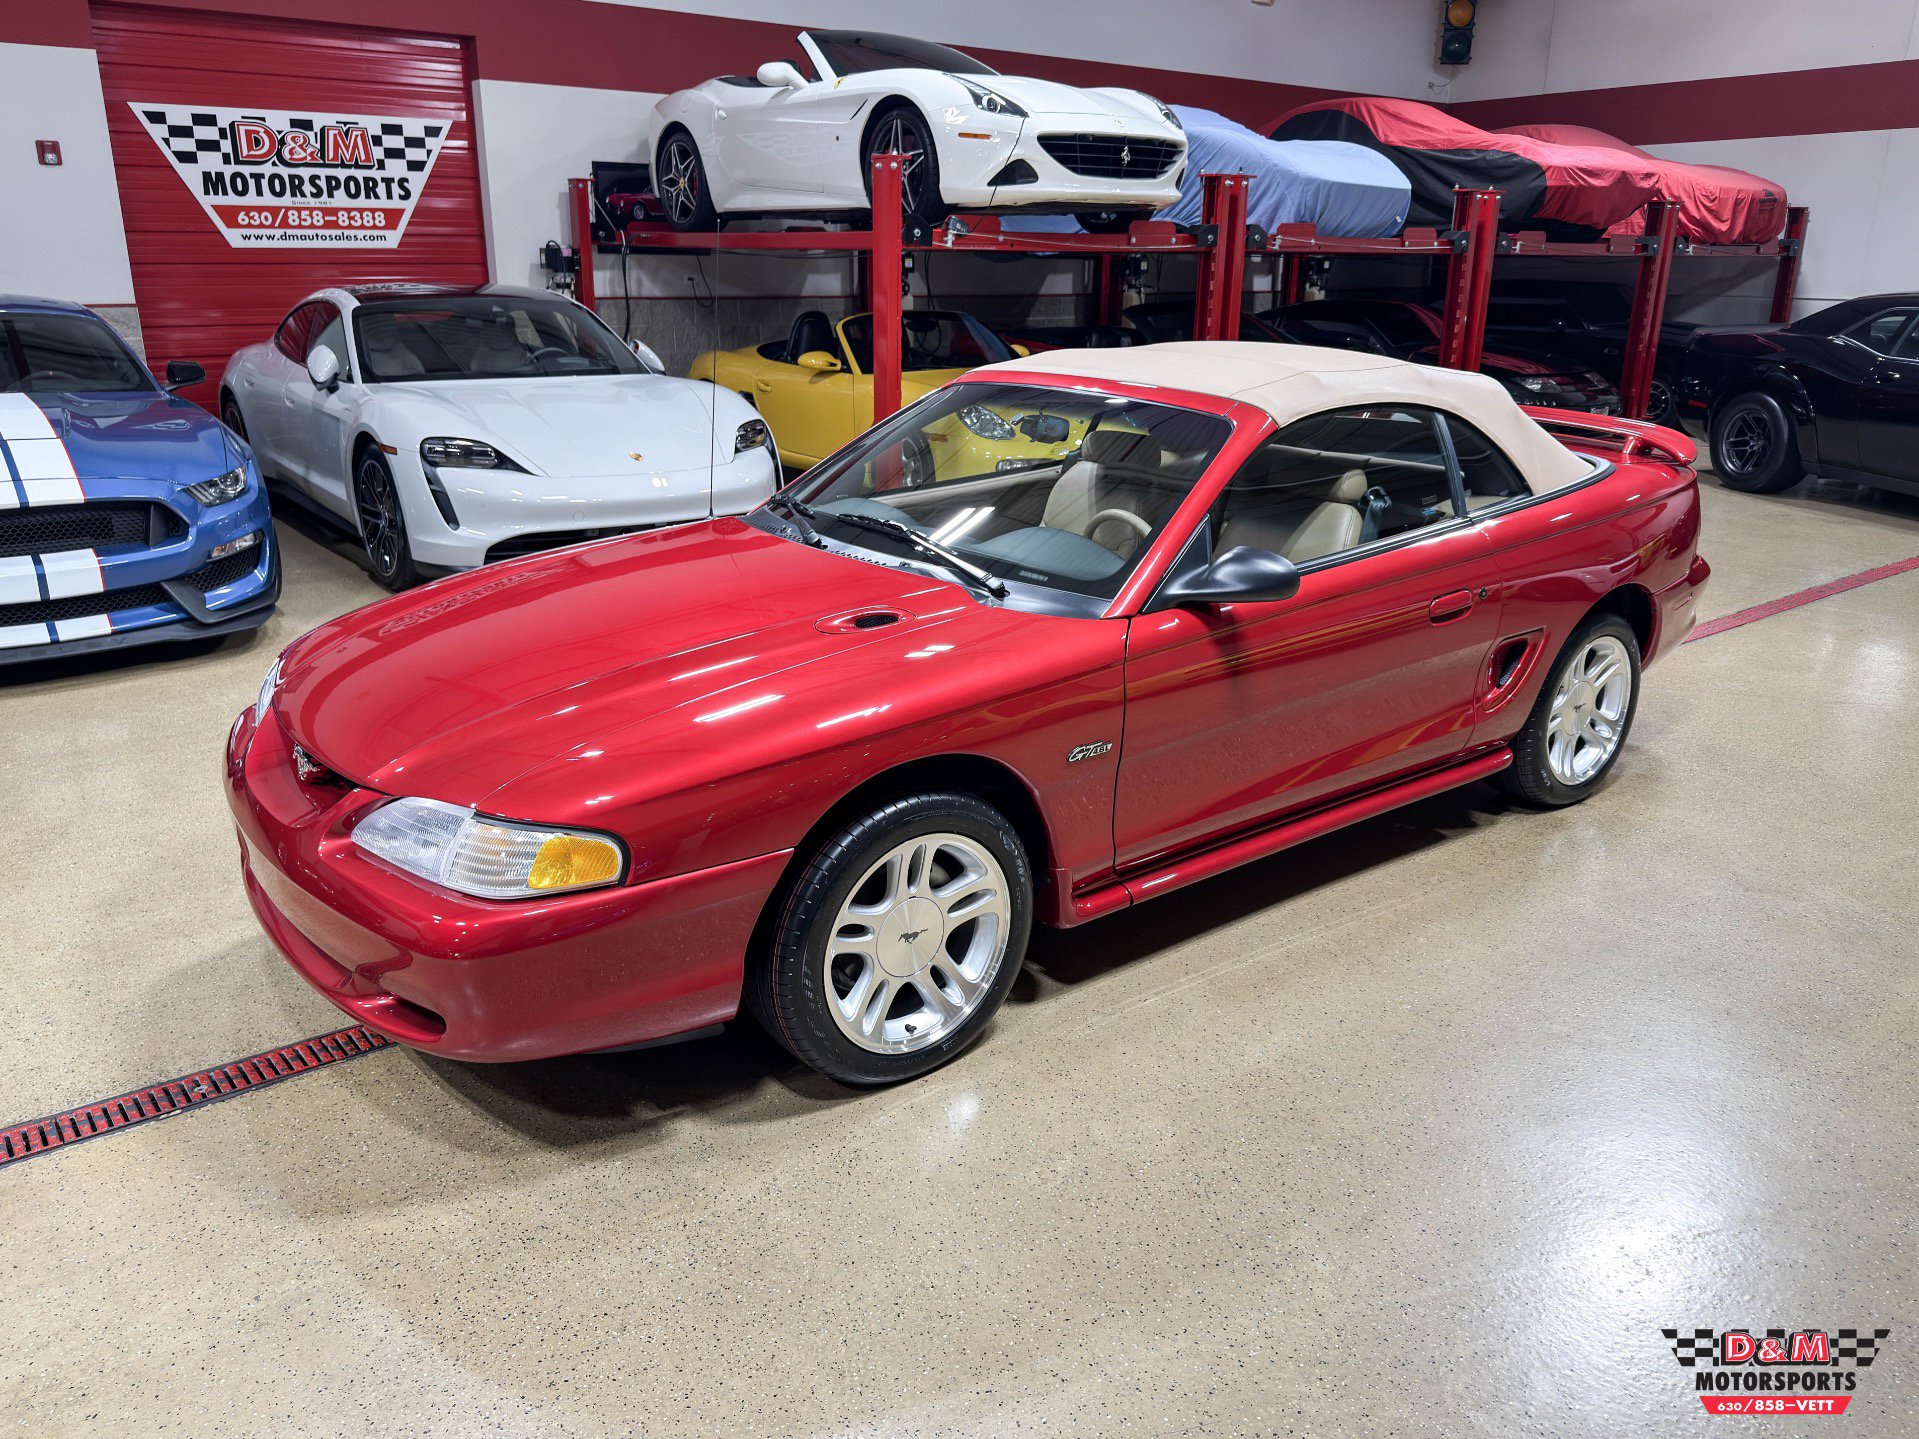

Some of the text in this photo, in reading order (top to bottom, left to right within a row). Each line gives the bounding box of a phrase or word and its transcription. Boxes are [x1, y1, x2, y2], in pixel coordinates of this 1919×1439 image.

[231, 121, 376, 169] D&M
[202, 171, 411, 201] MOTORSPORTS
[237, 208, 386, 228] 630/858-8388
[241, 231, 387, 243] www.dmautosales.com
